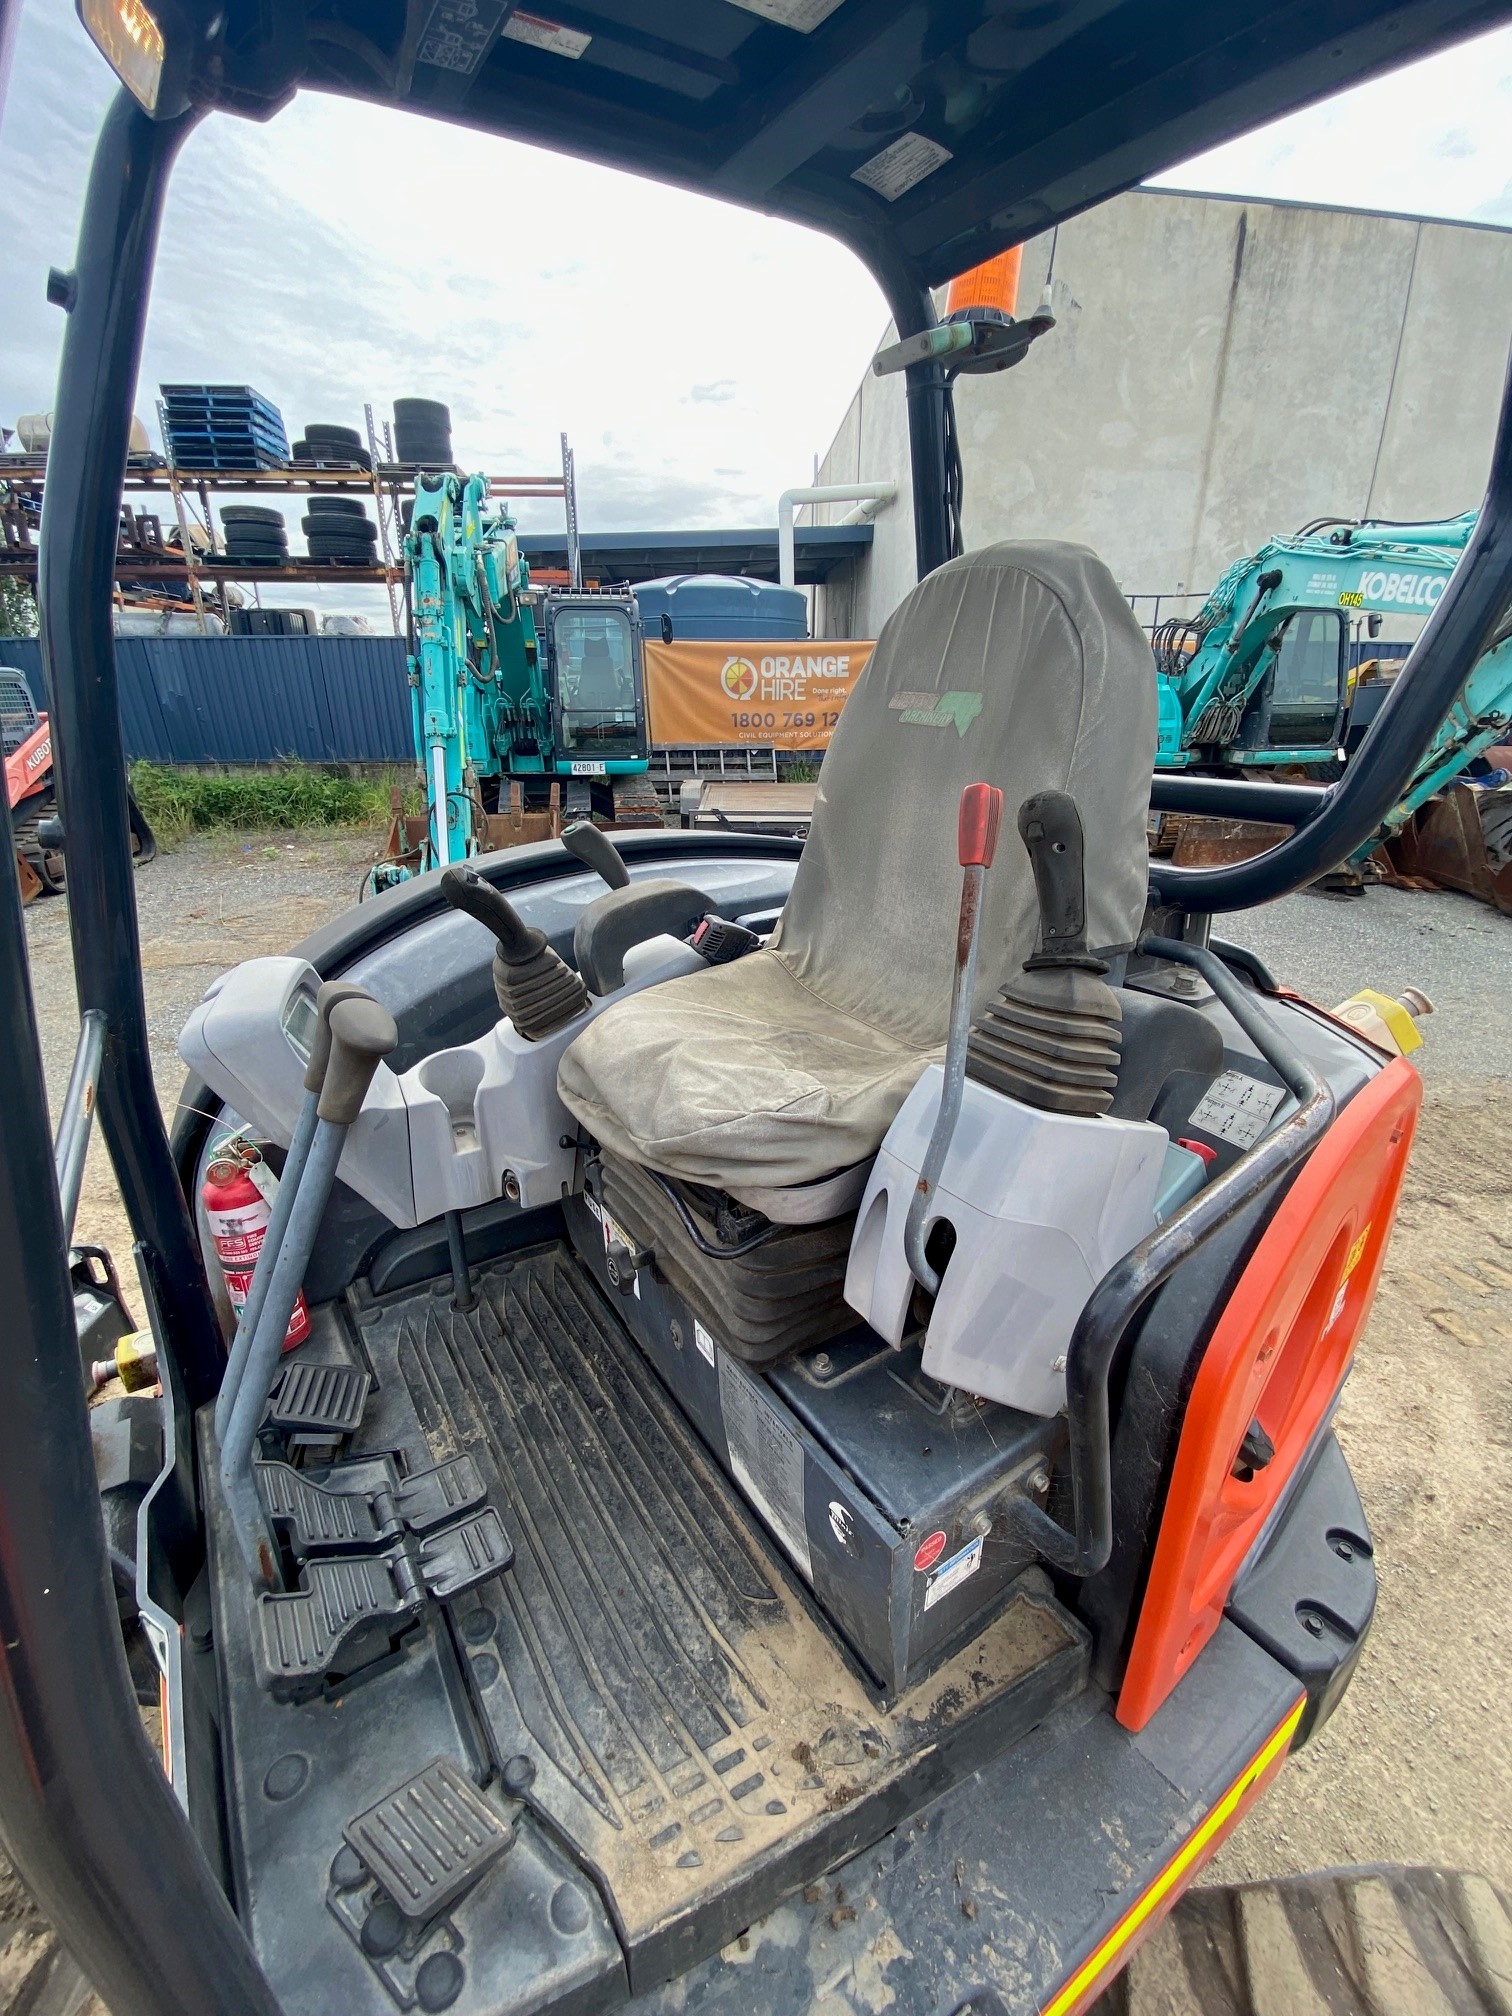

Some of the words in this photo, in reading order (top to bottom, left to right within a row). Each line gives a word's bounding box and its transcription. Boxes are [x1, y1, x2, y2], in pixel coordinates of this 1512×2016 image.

[1357, 571, 1447, 607] KOBELCO
[1339, 593, 1363, 606] OH145
[761, 656, 849, 678] ORANGE
[761, 679, 806, 701] HIRE
[829, 687, 847, 695] right.
[731, 713, 775, 727] 1800
[783, 713, 815, 727] 769
